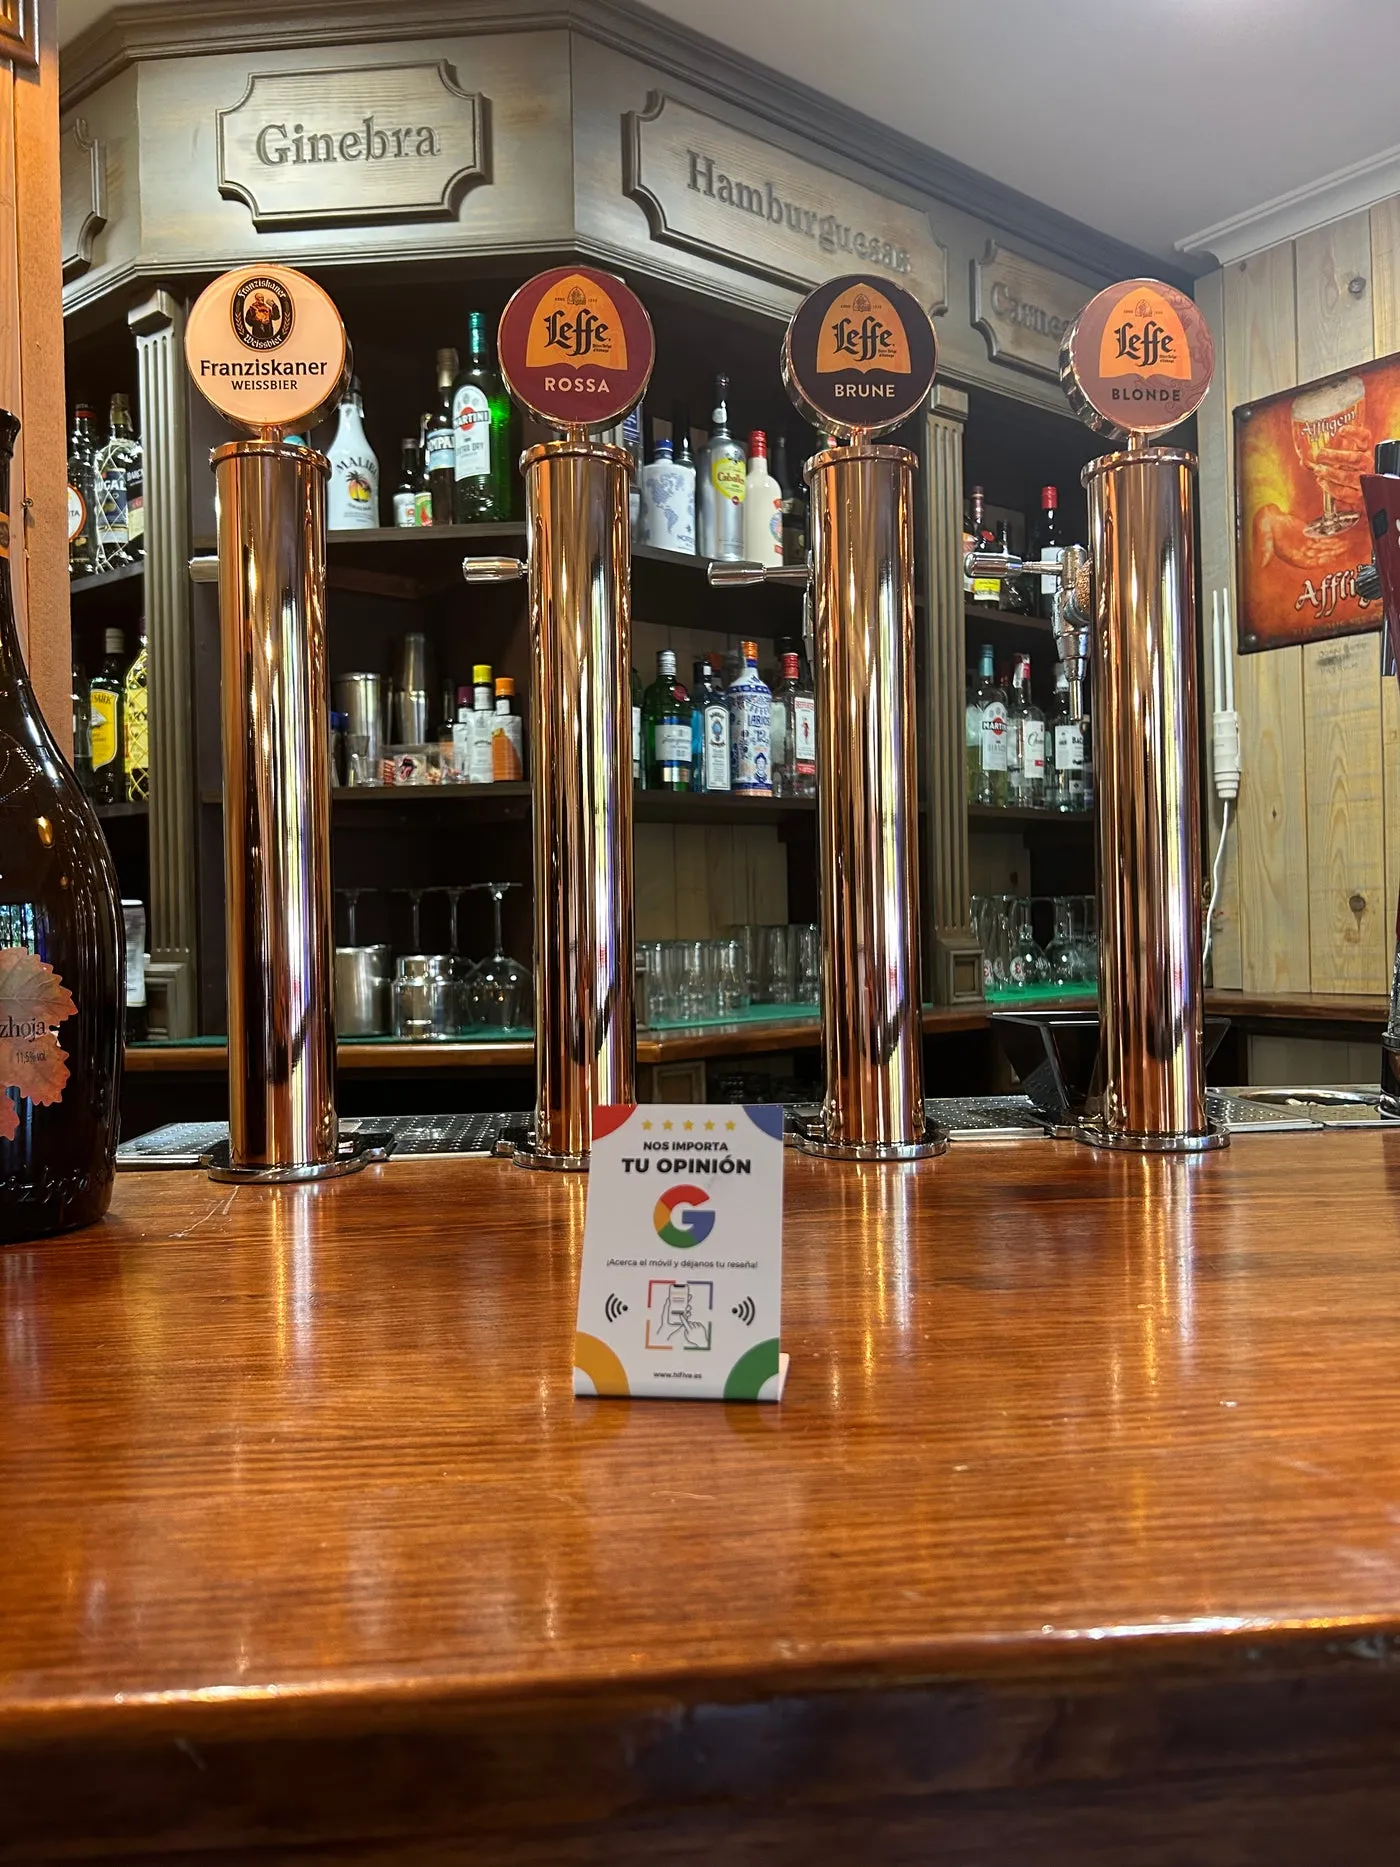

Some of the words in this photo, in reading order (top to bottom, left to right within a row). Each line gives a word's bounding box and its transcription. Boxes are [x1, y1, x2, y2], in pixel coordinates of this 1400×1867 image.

[256, 115, 441, 167] Ginebra
[687, 149, 912, 274] Hamburguesas
[237, 279, 287, 299] Franziskaner
[244, 334, 282, 349] Weissbier
[544, 308, 611, 357] Leffe
[832, 315, 895, 362] Leffe
[1114, 320, 1176, 367] Leffe
[200, 358, 328, 377] Franziskaner
[231, 380, 298, 391] WEISSBIER
[545, 377, 610, 393] ROSSA
[834, 384, 896, 398] BRUNE
[1111, 388, 1181, 401] BLONDE
[1295, 569, 1371, 619] Affli
[643, 1141, 670, 1151] NOS
[672, 1141, 729, 1151] IMPORTA
[622, 1158, 650, 1173] TU
[656, 1154, 752, 1174] OPINIÓN
[606, 1258, 638, 1267] ¡Acerca
[639, 1258, 647, 1266] el
[649, 1258, 672, 1267] móvil
[673, 1260, 678, 1268] y
[716, 1260, 725, 1268] tu
[727, 1260, 758, 1269] reseña!
